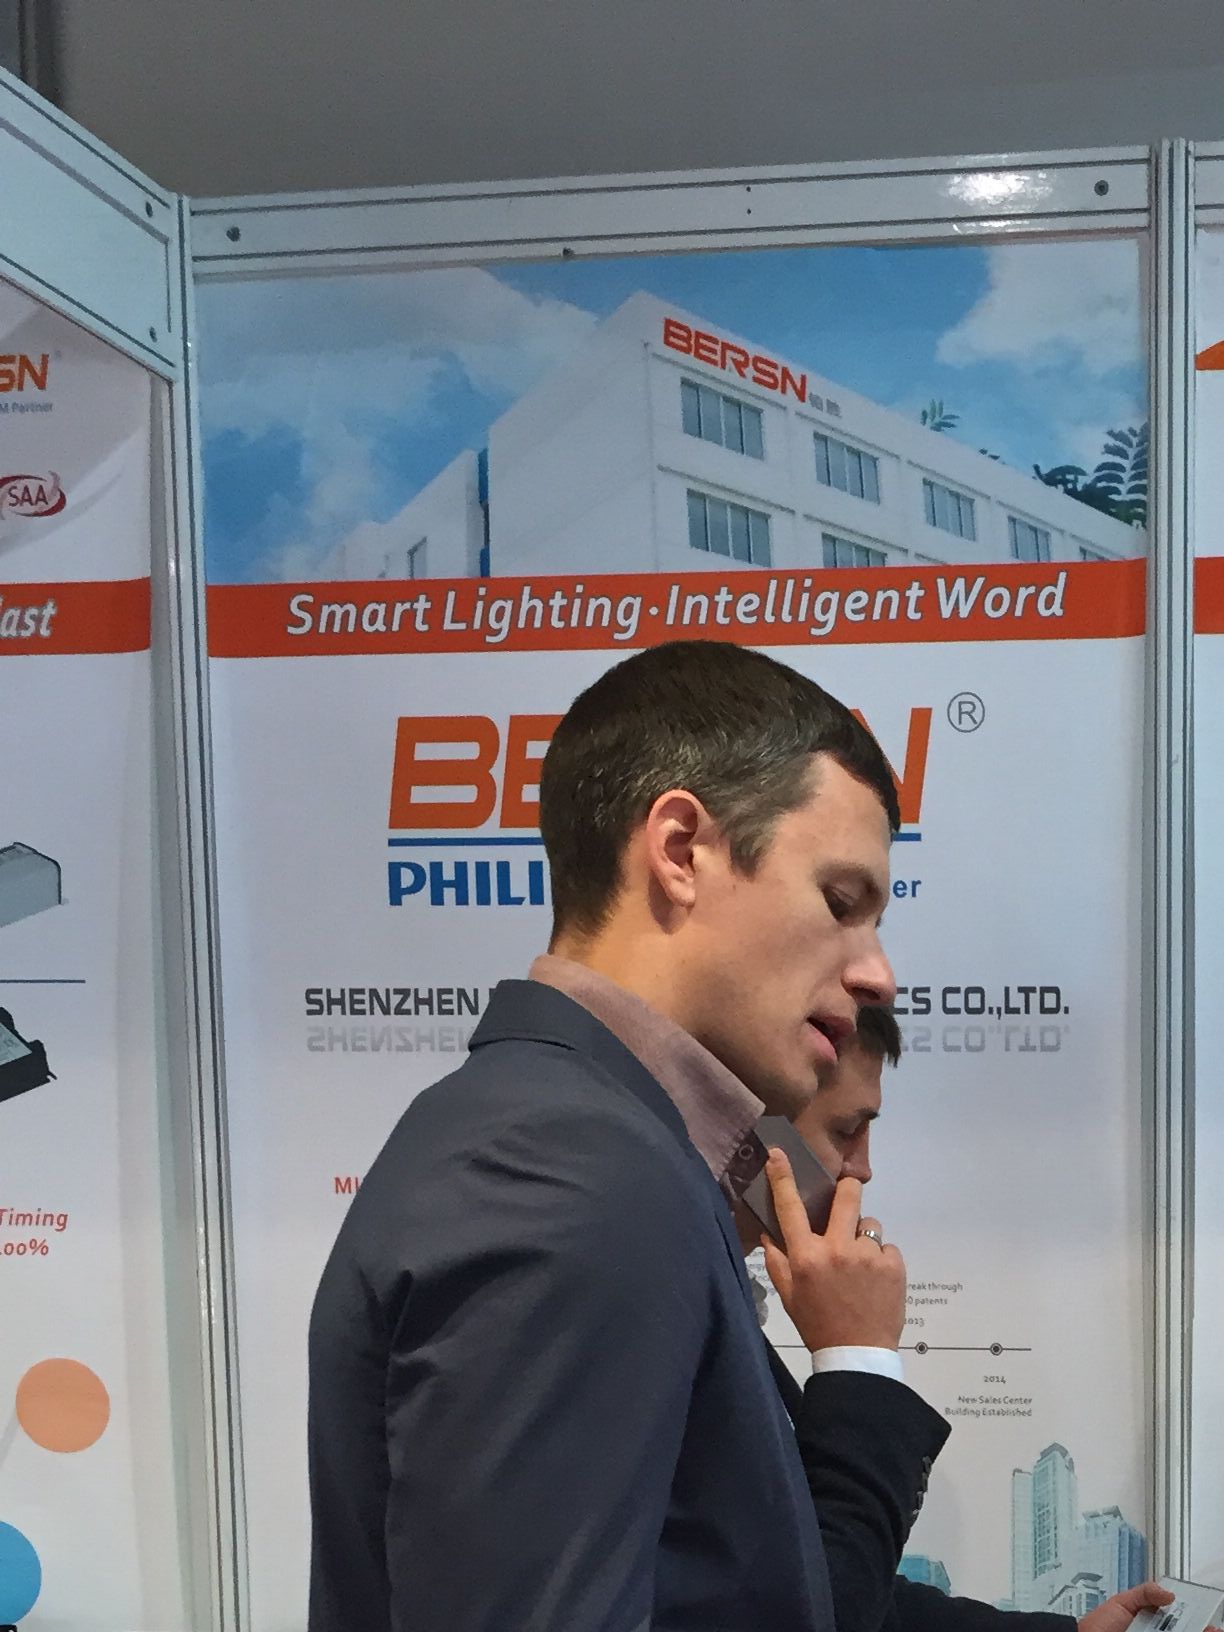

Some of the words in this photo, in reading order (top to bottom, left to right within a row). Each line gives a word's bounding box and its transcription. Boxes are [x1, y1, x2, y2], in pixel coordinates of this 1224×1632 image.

[663, 317, 806, 403] BERSN
[8, 485, 49, 507] SAA
[286, 593, 432, 636] Smart
[936, 571, 1068, 620] Word
[388, 861, 545, 906] PHILI
[305, 987, 479, 1016] SHENZHEN
[0, 1208, 68, 1232] Timing
[908, 1282, 926, 1291] reak
[928, 1282, 963, 1293] through
[915, 1297, 948, 1307] patents
[983, 1375, 1006, 1384] 2014
[979, 1395, 1002, 1405] Sales
[1003, 1396, 1033, 1405] Center
[944, 1408, 981, 1419] Building
[982, 1408, 1033, 1417] Established
